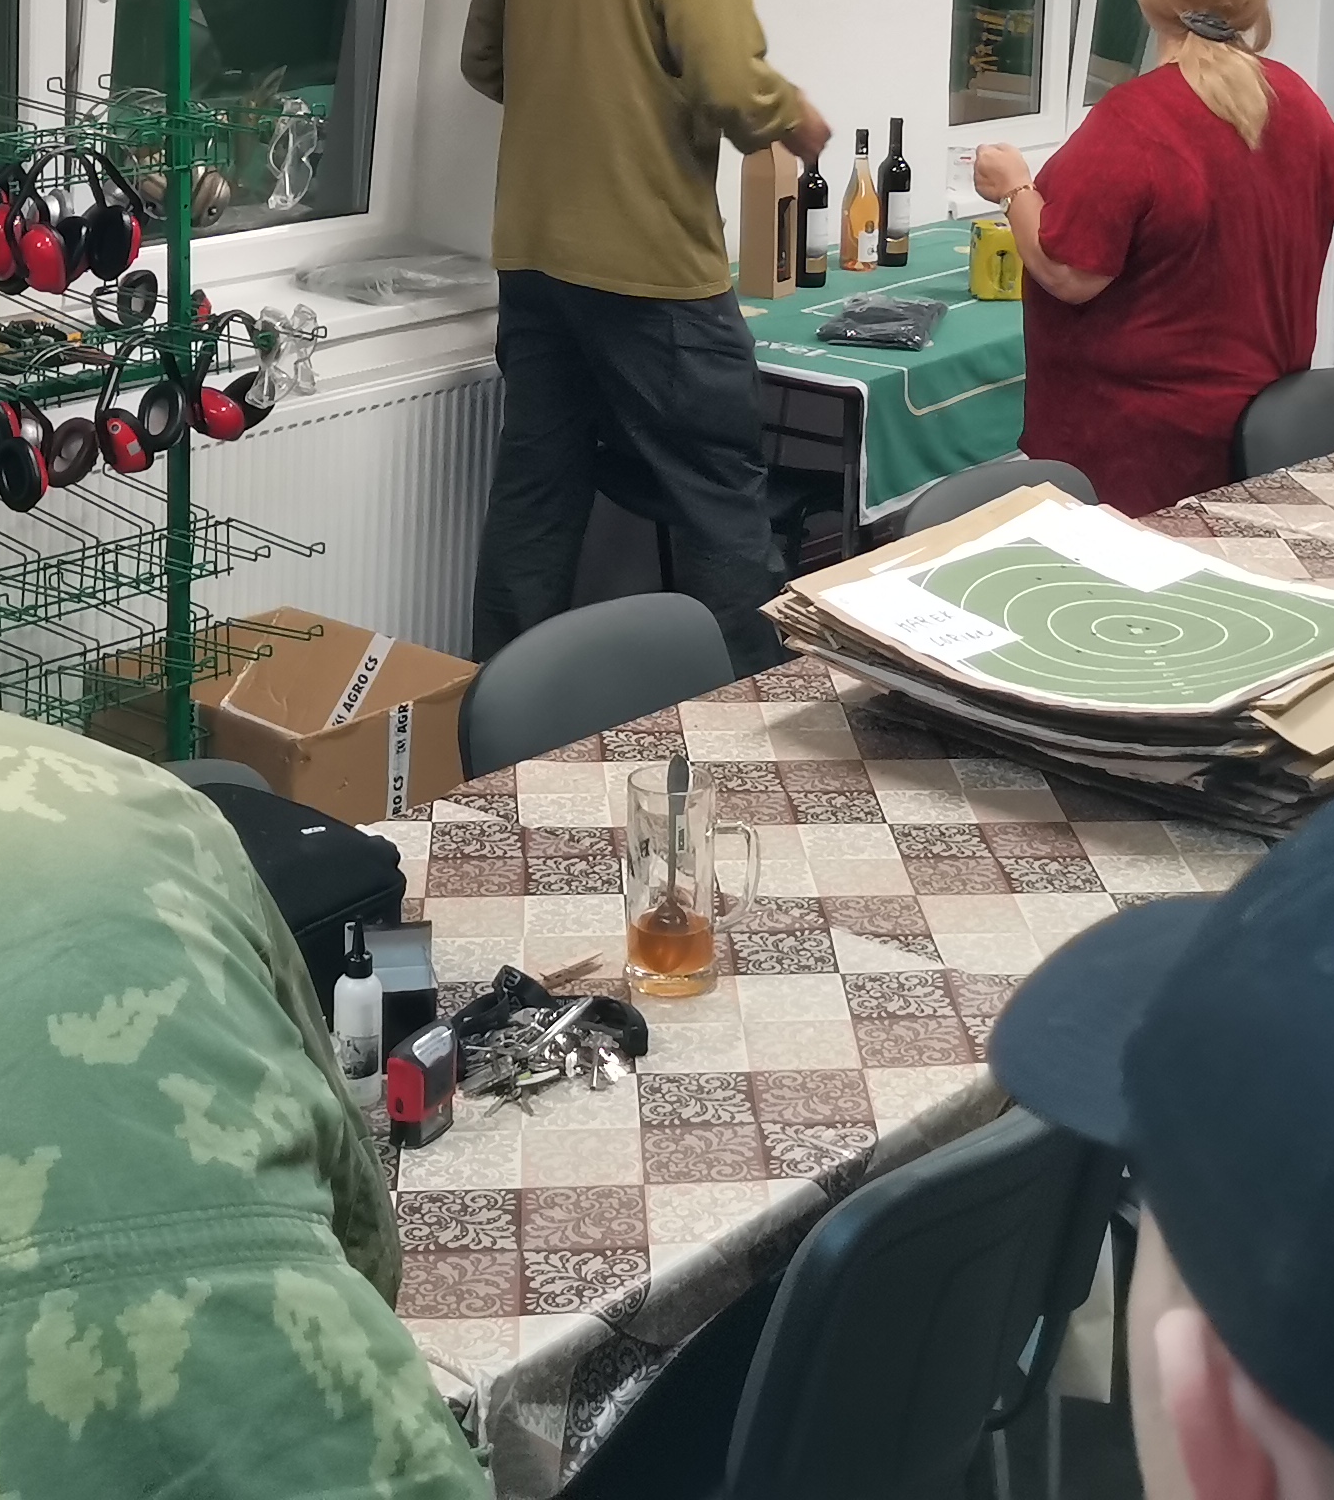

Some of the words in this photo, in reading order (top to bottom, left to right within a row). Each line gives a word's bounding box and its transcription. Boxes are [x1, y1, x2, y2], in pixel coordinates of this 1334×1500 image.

[342, 673, 370, 714] AGRO
[364, 654, 379, 672] CS
[393, 775, 404, 791] CS
